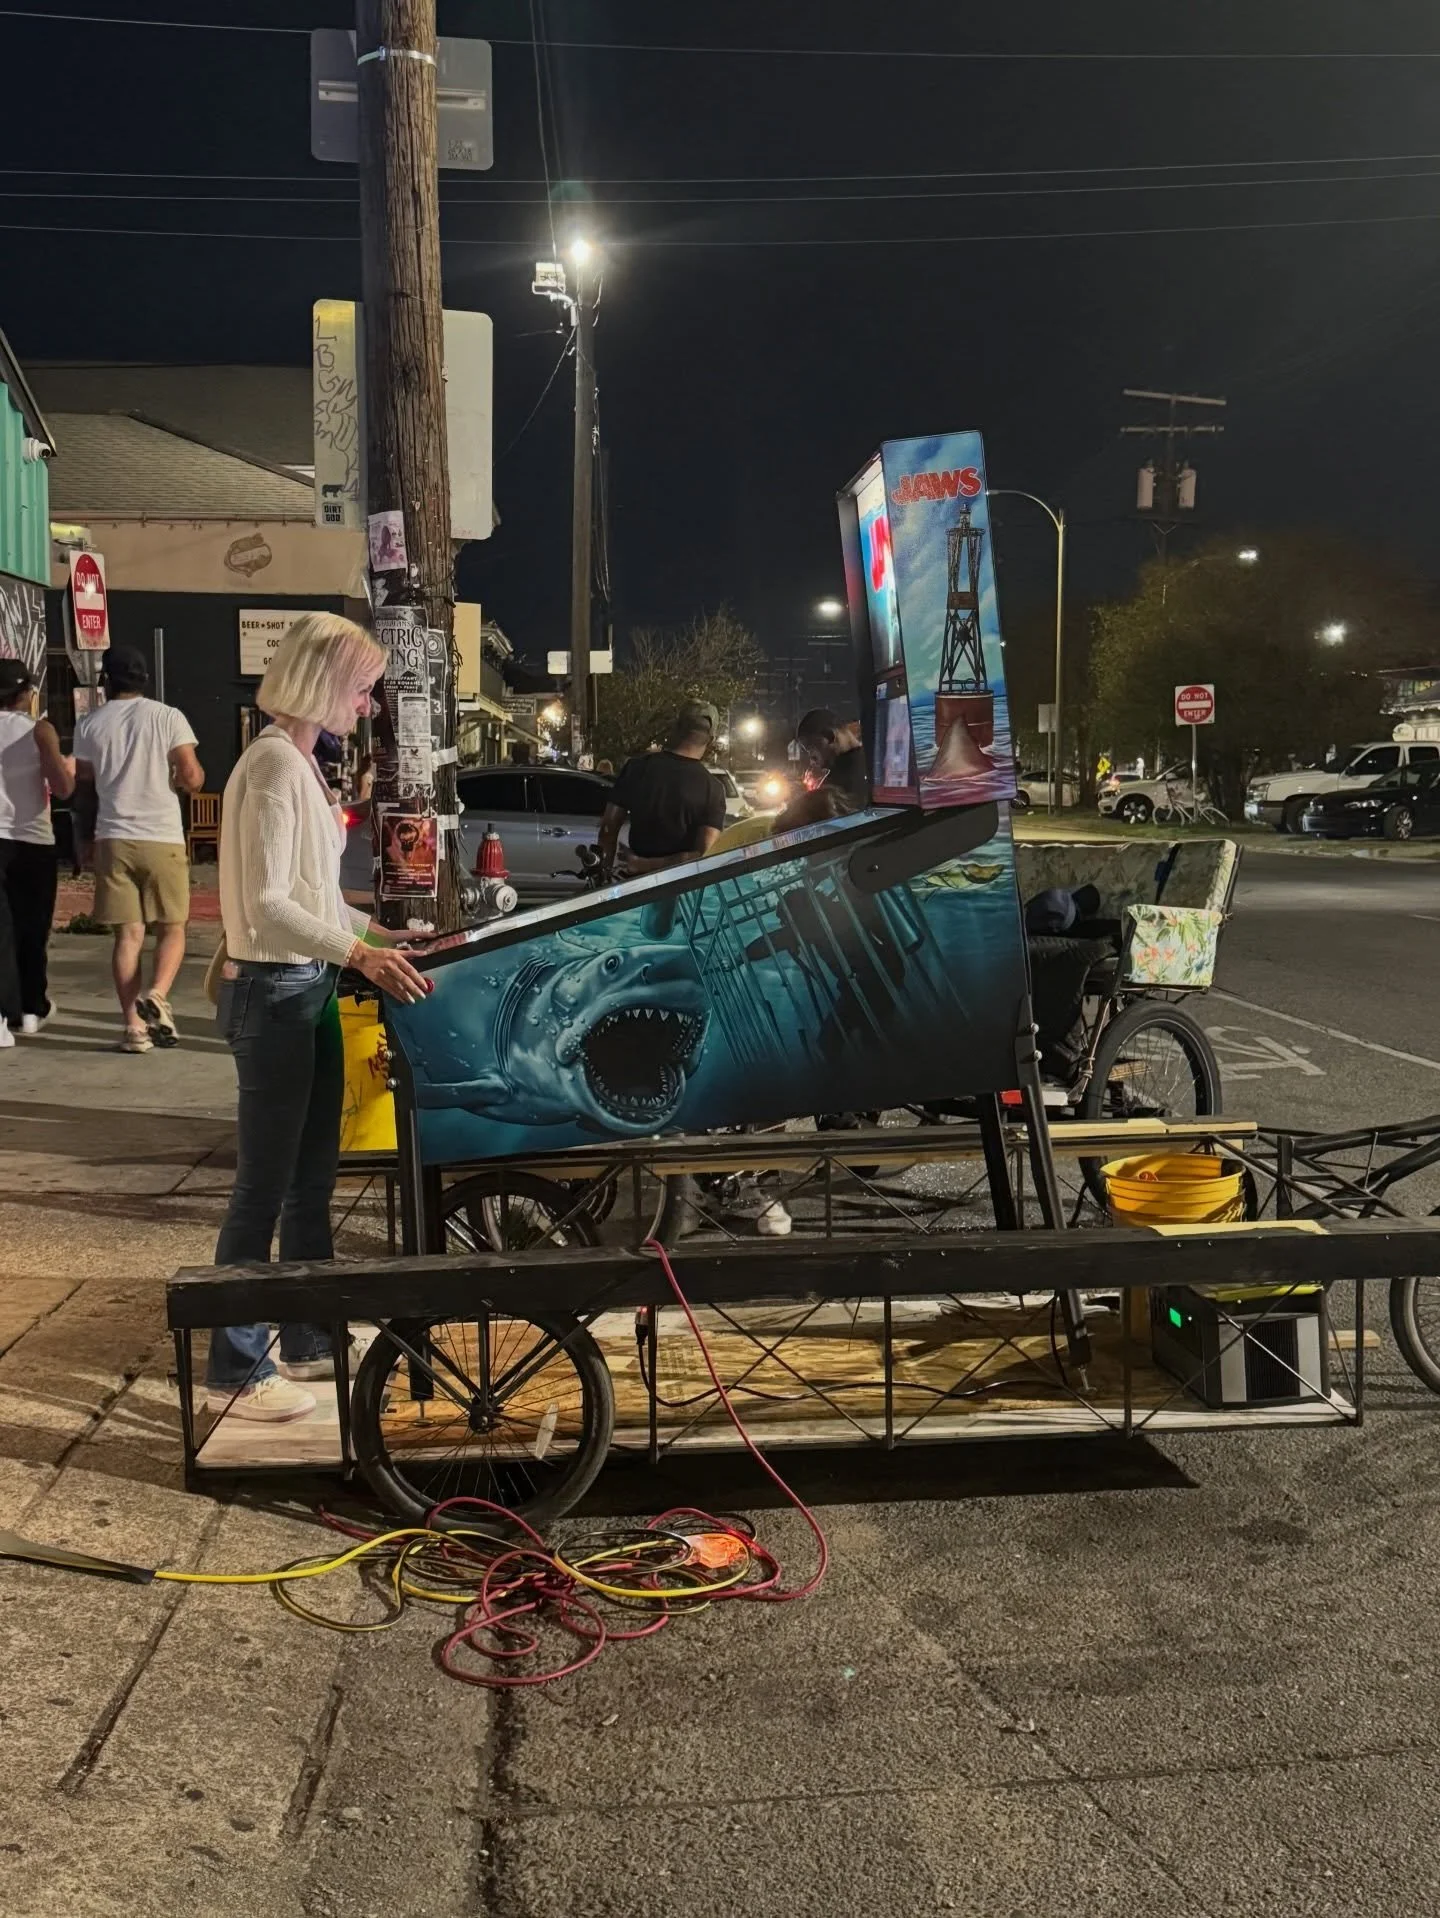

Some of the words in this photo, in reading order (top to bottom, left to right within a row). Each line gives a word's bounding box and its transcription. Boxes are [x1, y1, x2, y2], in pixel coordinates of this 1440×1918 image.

[891, 466, 982, 506] JAWS
[76, 571, 86, 588] DO
[82, 614, 101, 629] ENTER
[241, 621, 260, 629] BEER
[266, 621, 285, 630] SHOT
[1181, 692, 1191, 700] DO
[1194, 692, 1208, 700] NOT
[1183, 709, 1207, 718] ENTER
